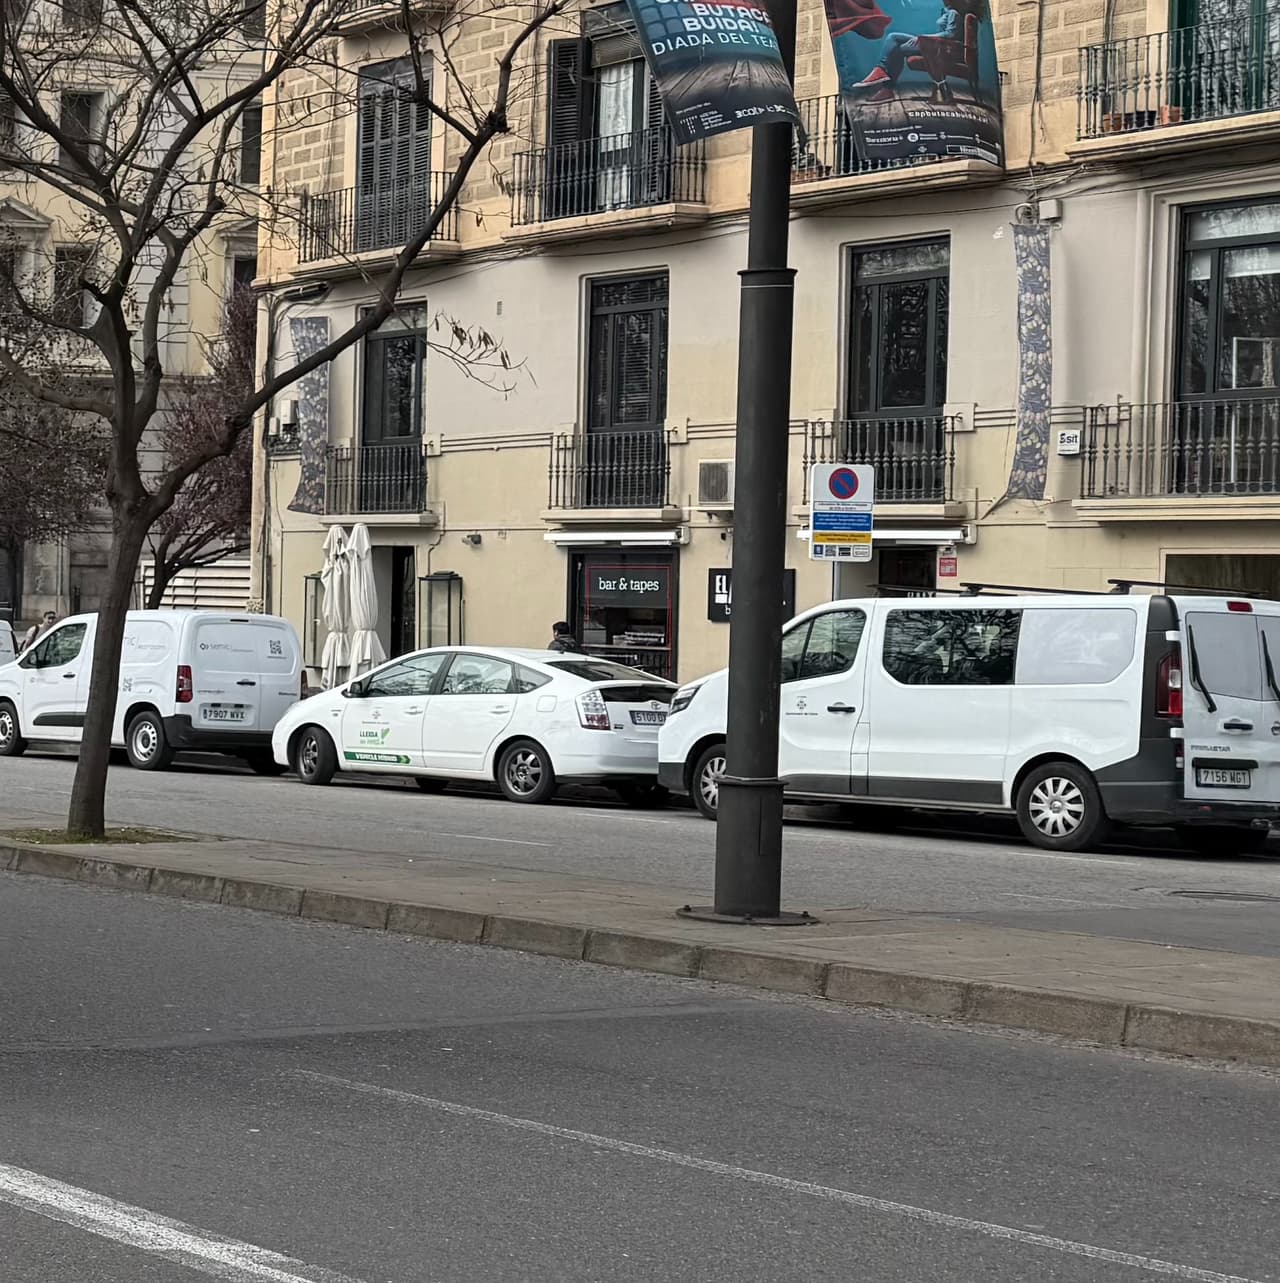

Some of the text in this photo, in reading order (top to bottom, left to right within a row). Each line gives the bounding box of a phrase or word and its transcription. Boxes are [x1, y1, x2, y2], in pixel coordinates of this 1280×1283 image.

[682, 17, 759, 33] BUIDA!
[651, 33, 714, 56] DIADA
[717, 32, 749, 45] DEL
[599, 577, 660, 594] bar & tapes
[1203, 770, 1228, 782] 7156
